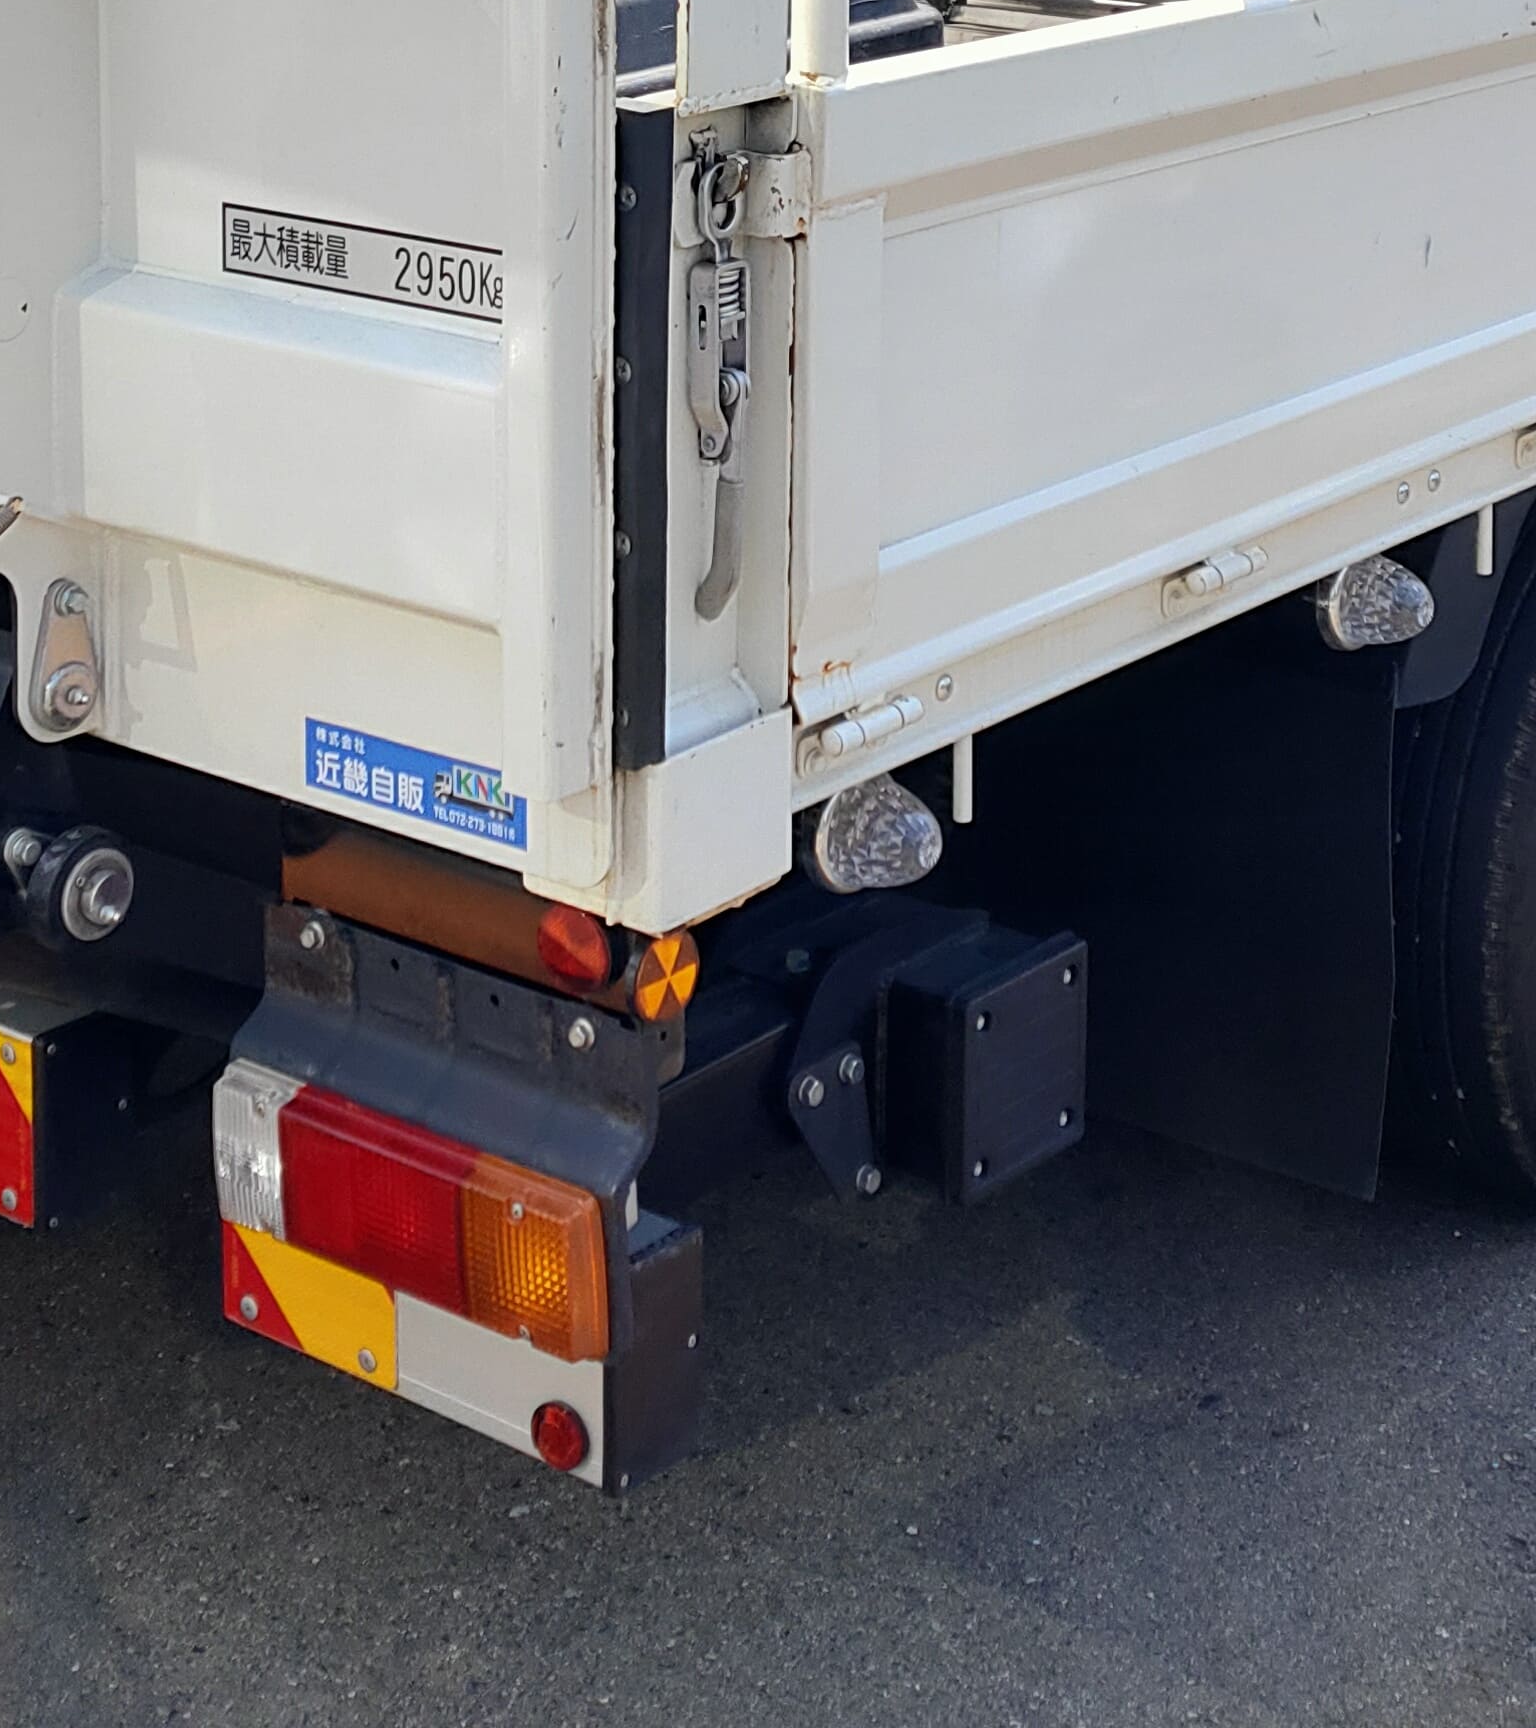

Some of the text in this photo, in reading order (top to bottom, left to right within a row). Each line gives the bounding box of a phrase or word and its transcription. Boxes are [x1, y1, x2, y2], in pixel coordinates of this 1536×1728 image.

[230, 218, 503, 310] 最大積載量 2950Kg
[315, 726, 366, 756] 株式会社
[315, 749, 425, 815] 近畿自販
